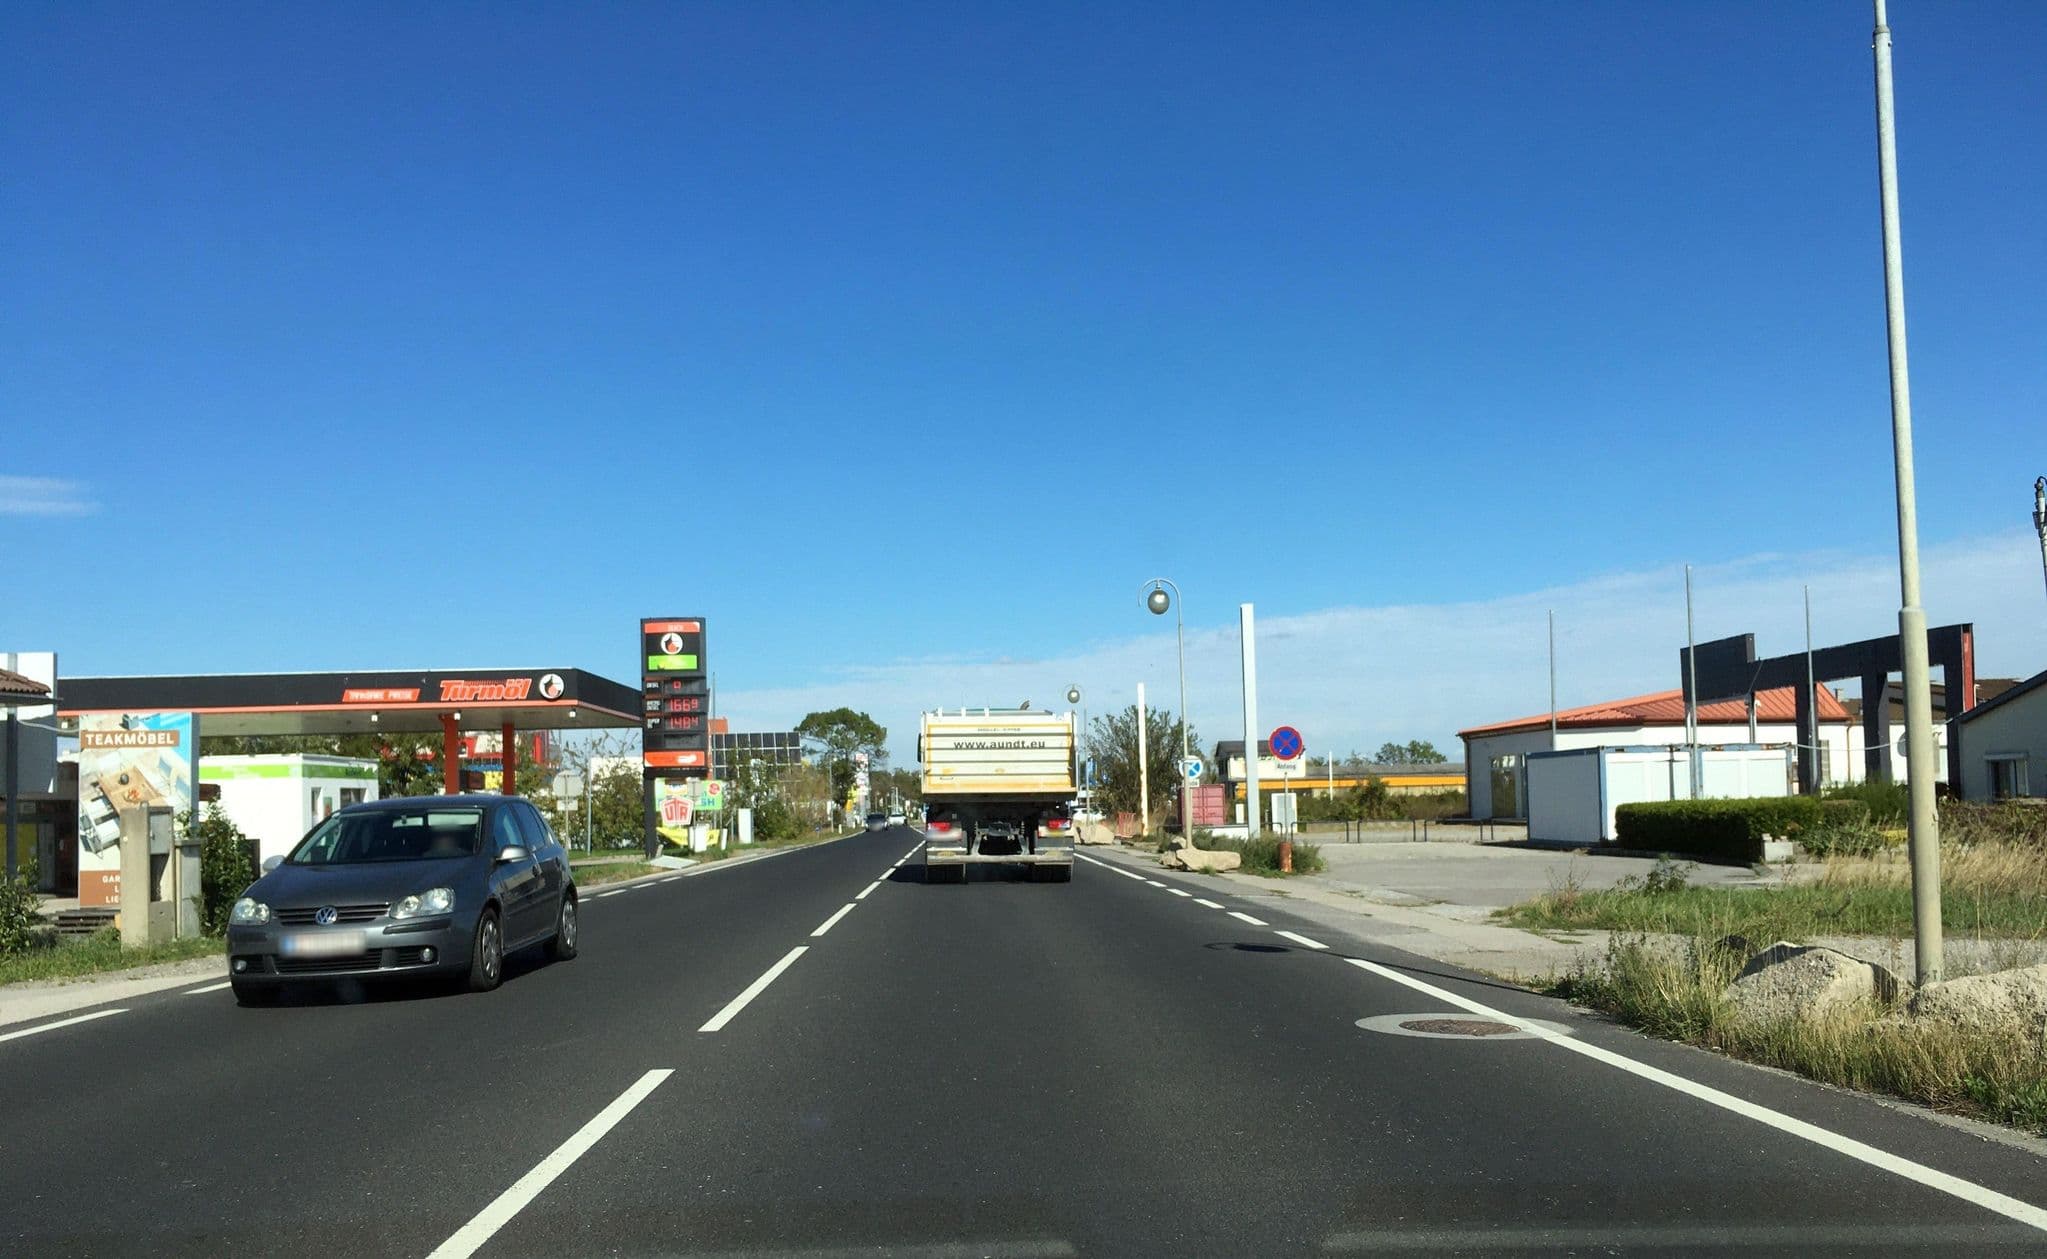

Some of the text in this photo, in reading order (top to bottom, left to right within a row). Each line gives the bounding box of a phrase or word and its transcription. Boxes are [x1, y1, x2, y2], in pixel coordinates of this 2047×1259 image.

[440, 678, 533, 702] Turmöl
[85, 731, 174, 746] TEAKMÖBEL
[953, 740, 1046, 750] www.aundt.eu
[102, 875, 121, 883] GAR
